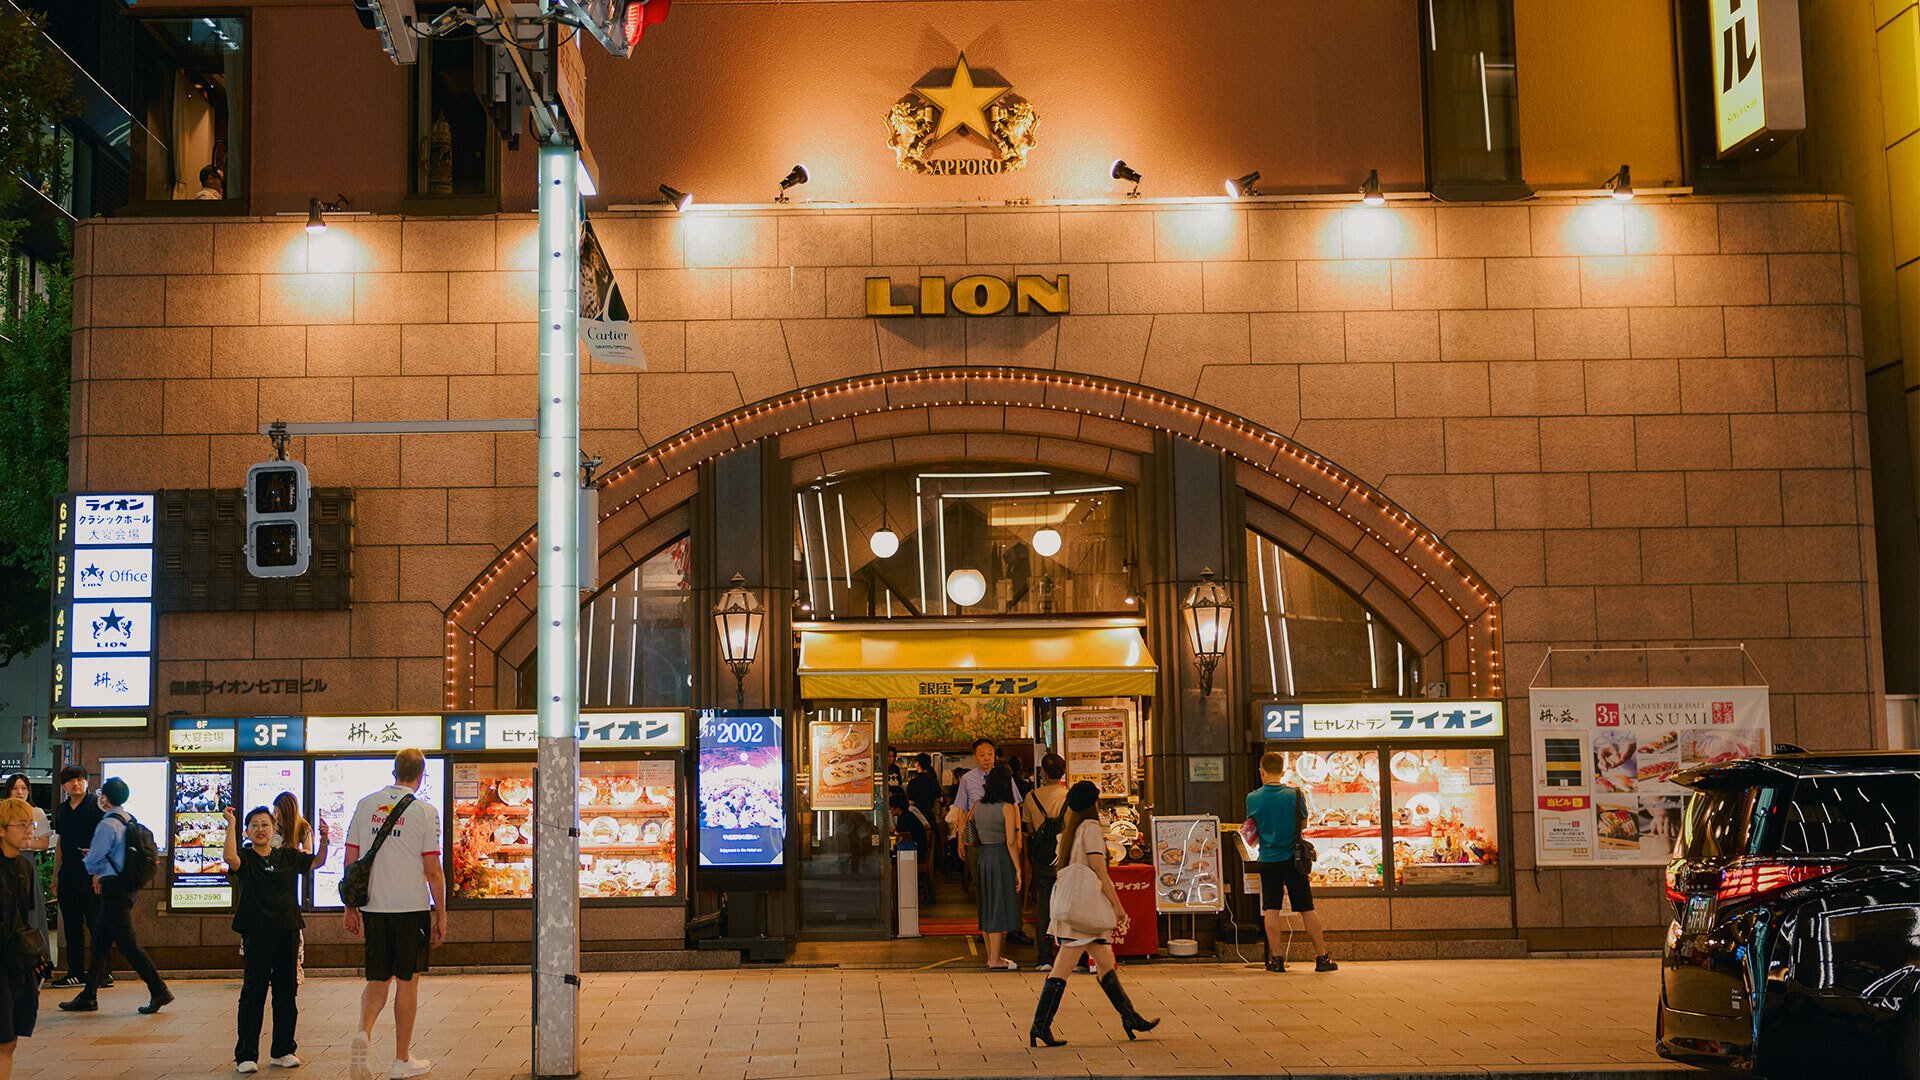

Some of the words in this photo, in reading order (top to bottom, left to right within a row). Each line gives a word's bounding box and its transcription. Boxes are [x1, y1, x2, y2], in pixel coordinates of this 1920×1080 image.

[1722, 0, 1757, 94] ル
[925, 158, 1002, 176] SAPPORO
[865, 274, 1071, 318] LION
[587, 326, 629, 340] Cartier
[85, 499, 144, 511] ライオン
[59, 502, 67, 541] 6F
[78, 514, 151, 525] クラシックホール
[57, 556, 66, 595] 5F
[110, 569, 148, 583] Office
[55, 609, 65, 648] 4F
[54, 663, 63, 702] 3F
[170, 679, 327, 695] 銀座ライオン七丁目ビル
[918, 678, 1038, 695] 銀座ライオン
[1597, 705, 1618, 724] 3F
[1623, 703, 1662, 711] JAPANESE
[196, 720, 208, 729] 6F
[1267, 710, 1300, 733] 2F
[1313, 719, 1386, 731] ビヤレストラン
[1390, 710, 1493, 729] ライオン
[1623, 713, 1707, 726] MASUMI
[254, 724, 288, 746] 3F
[451, 721, 481, 744] 1F
[717, 722, 763, 743] 2002
[1115, 882, 1150, 890] ライオン
[174, 893, 221, 901] 03-3571-2590
